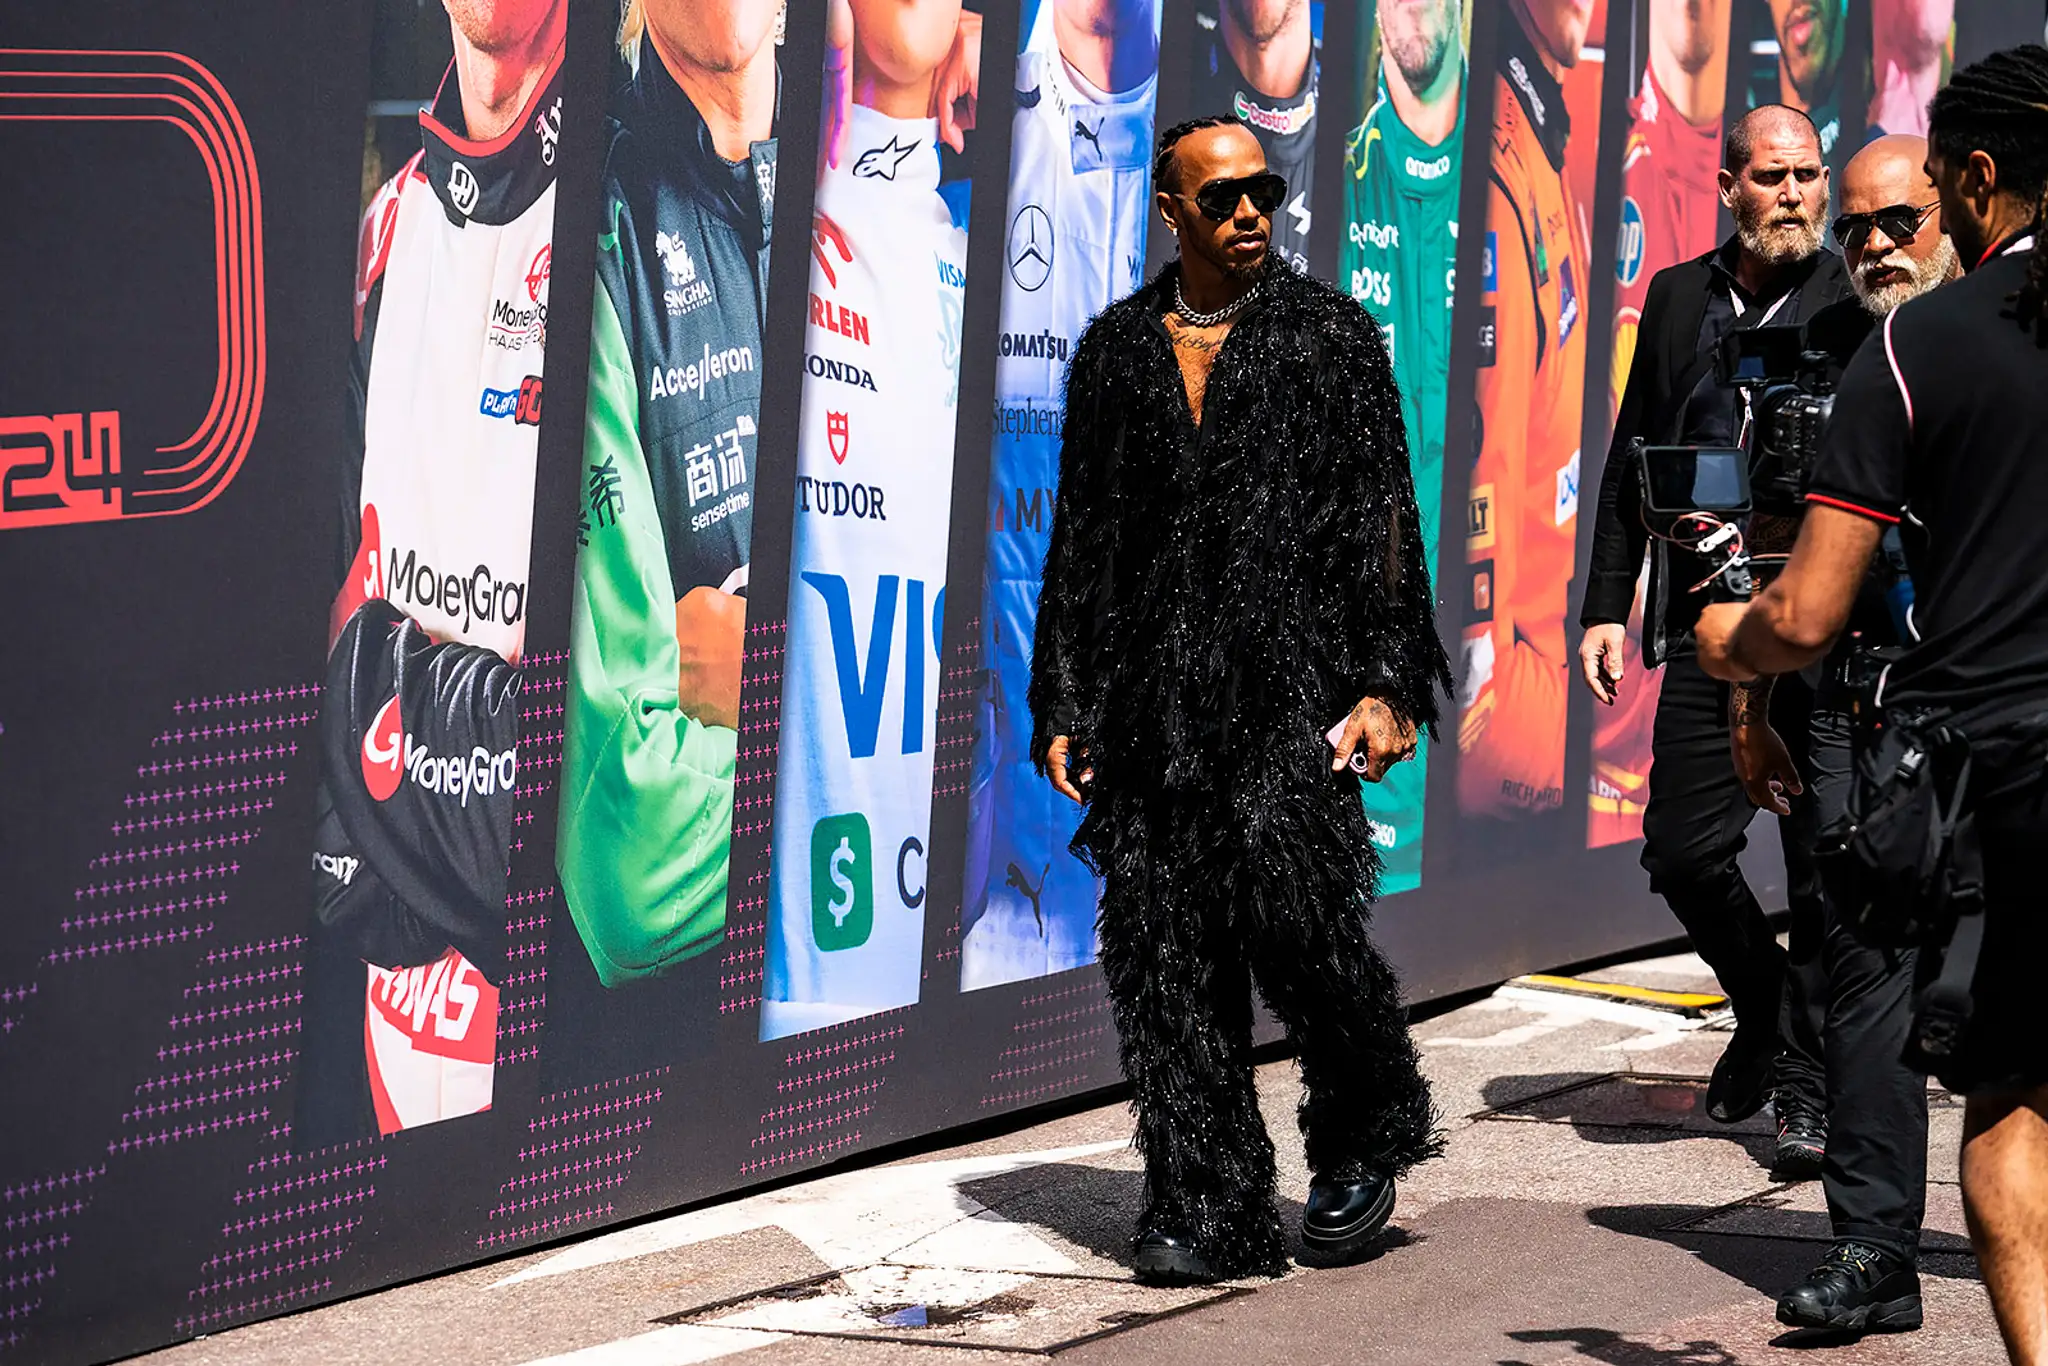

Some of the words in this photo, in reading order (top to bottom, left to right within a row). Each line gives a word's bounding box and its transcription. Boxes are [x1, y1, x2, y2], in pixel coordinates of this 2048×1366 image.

[1351, 266, 1391, 307] BOSS
[998, 328, 1068, 361] OMATSU
[650, 342, 754, 401] Accelleron
[691, 491, 750, 533] sensetime
[796, 475, 887, 521] TUDOR
[403, 732, 517, 808] MoneyGra
